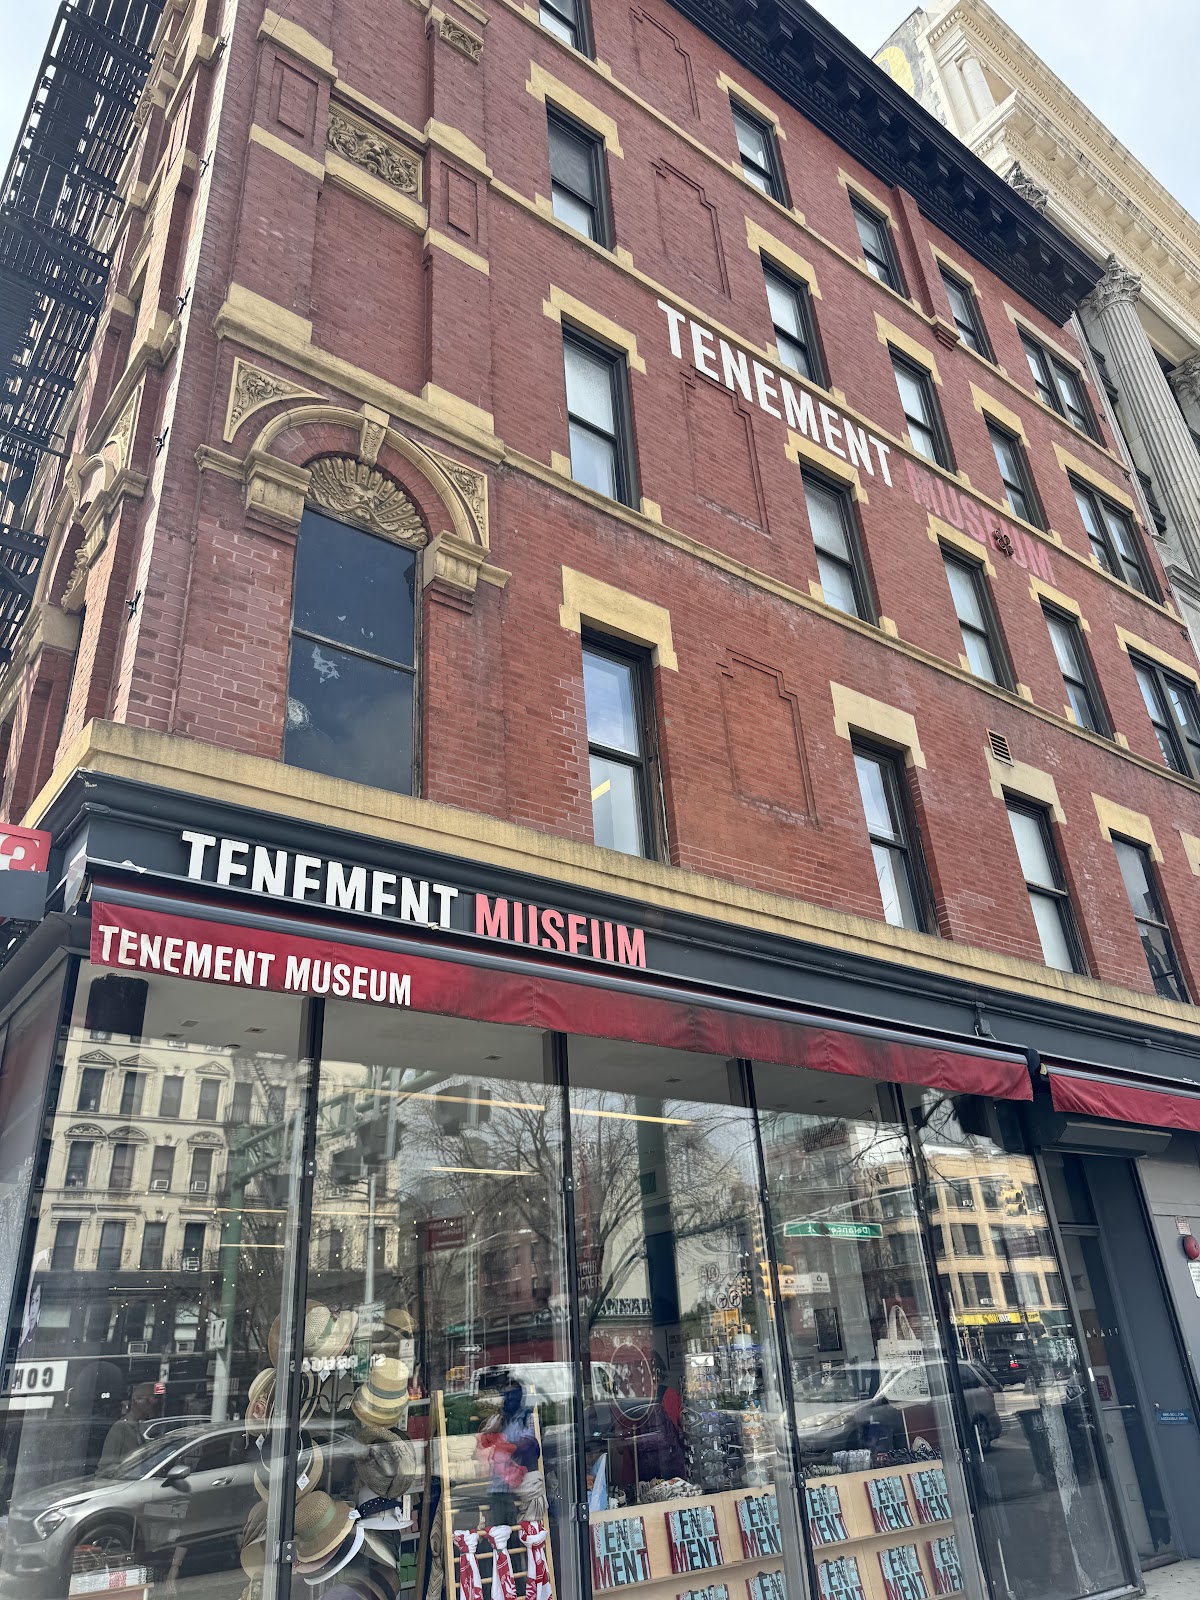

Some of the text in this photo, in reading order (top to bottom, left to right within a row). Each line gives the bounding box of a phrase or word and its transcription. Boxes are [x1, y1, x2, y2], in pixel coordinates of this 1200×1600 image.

[657, 299, 1058, 586] TENEMENT MUSEUM
[182, 830, 647, 969] TENEMENT MUSEUM
[98, 924, 411, 1006] TENEMENT MUSEUM
[577, 1273, 603, 1291] ICKETS
[578, 1260, 598, 1276] TOUR
[809, 1513, 848, 1546] MENT
[872, 1501, 915, 1534] MENT
[594, 1548, 650, 1590] MENT
[672, 1536, 723, 1575] MENT
